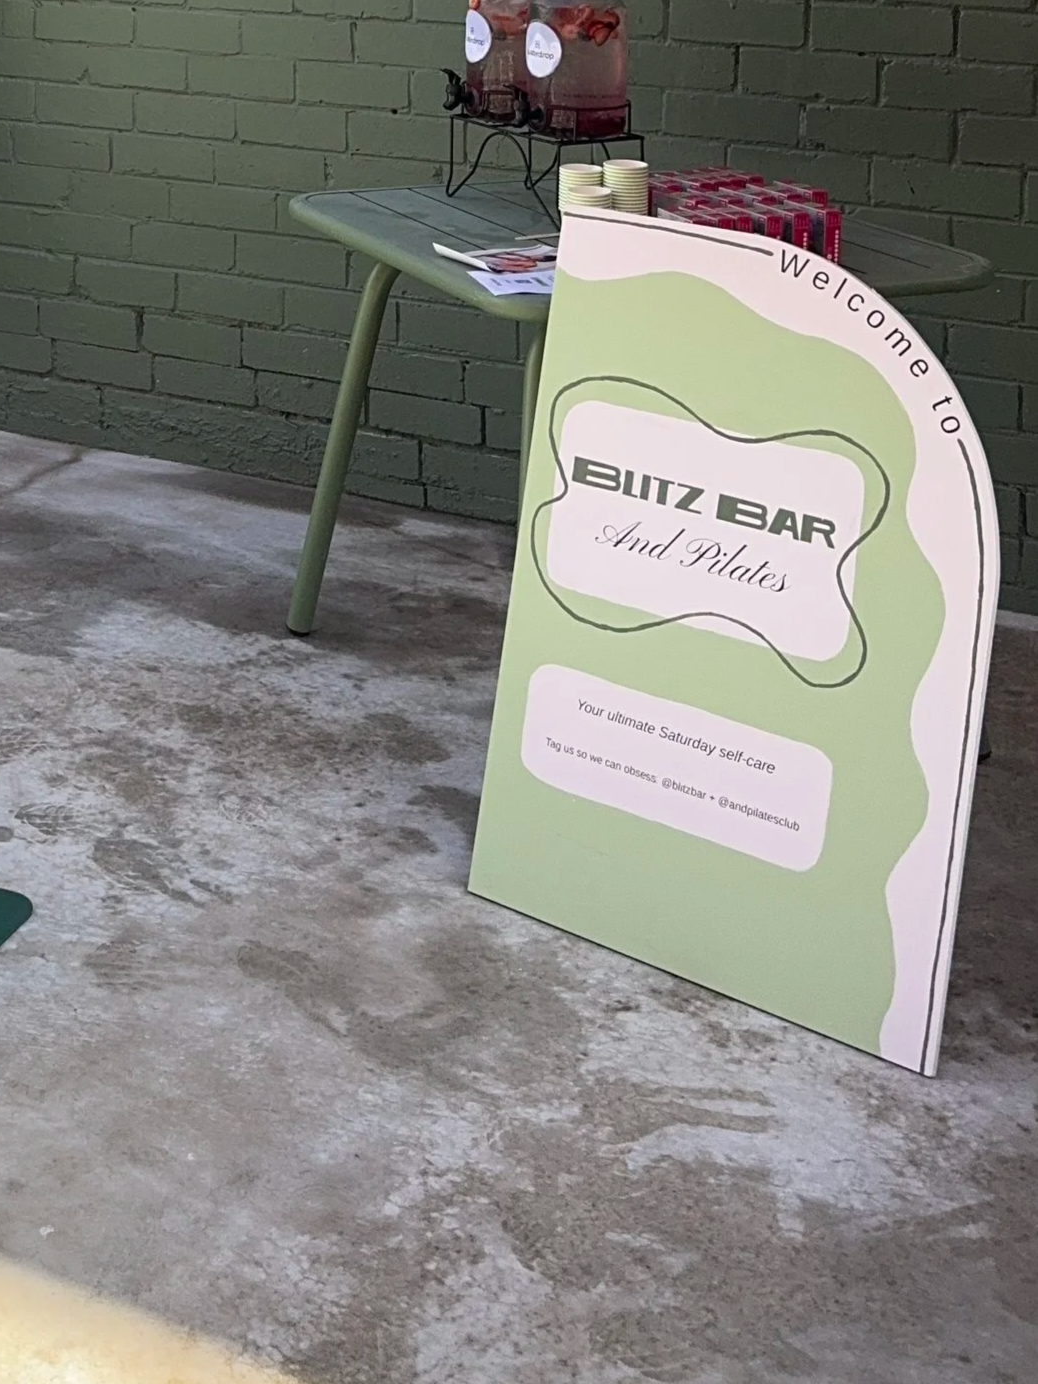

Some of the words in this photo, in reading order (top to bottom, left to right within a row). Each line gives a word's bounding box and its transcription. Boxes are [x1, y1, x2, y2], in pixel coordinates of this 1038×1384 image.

[780, 248, 930, 378] Welcome
[931, 395, 961, 434] to
[571, 455, 705, 515] BLITZ
[715, 493, 836, 550] BAR
[594, 521, 686, 561] And
[679, 538, 792, 593] Pilates
[545, 736, 562, 753] Tag
[563, 744, 575, 756] us
[576, 748, 589, 760] so
[589, 752, 604, 765] we
[604, 757, 622, 772] can
[661, 777, 707, 800] @blitzbar
[718, 795, 801, 832] @andpilatesclub
[577, 698, 606, 718] Your
[606, 710, 656, 736] ultimate
[658, 726, 717, 757] Saturday
[718, 744, 777, 775] self-care
